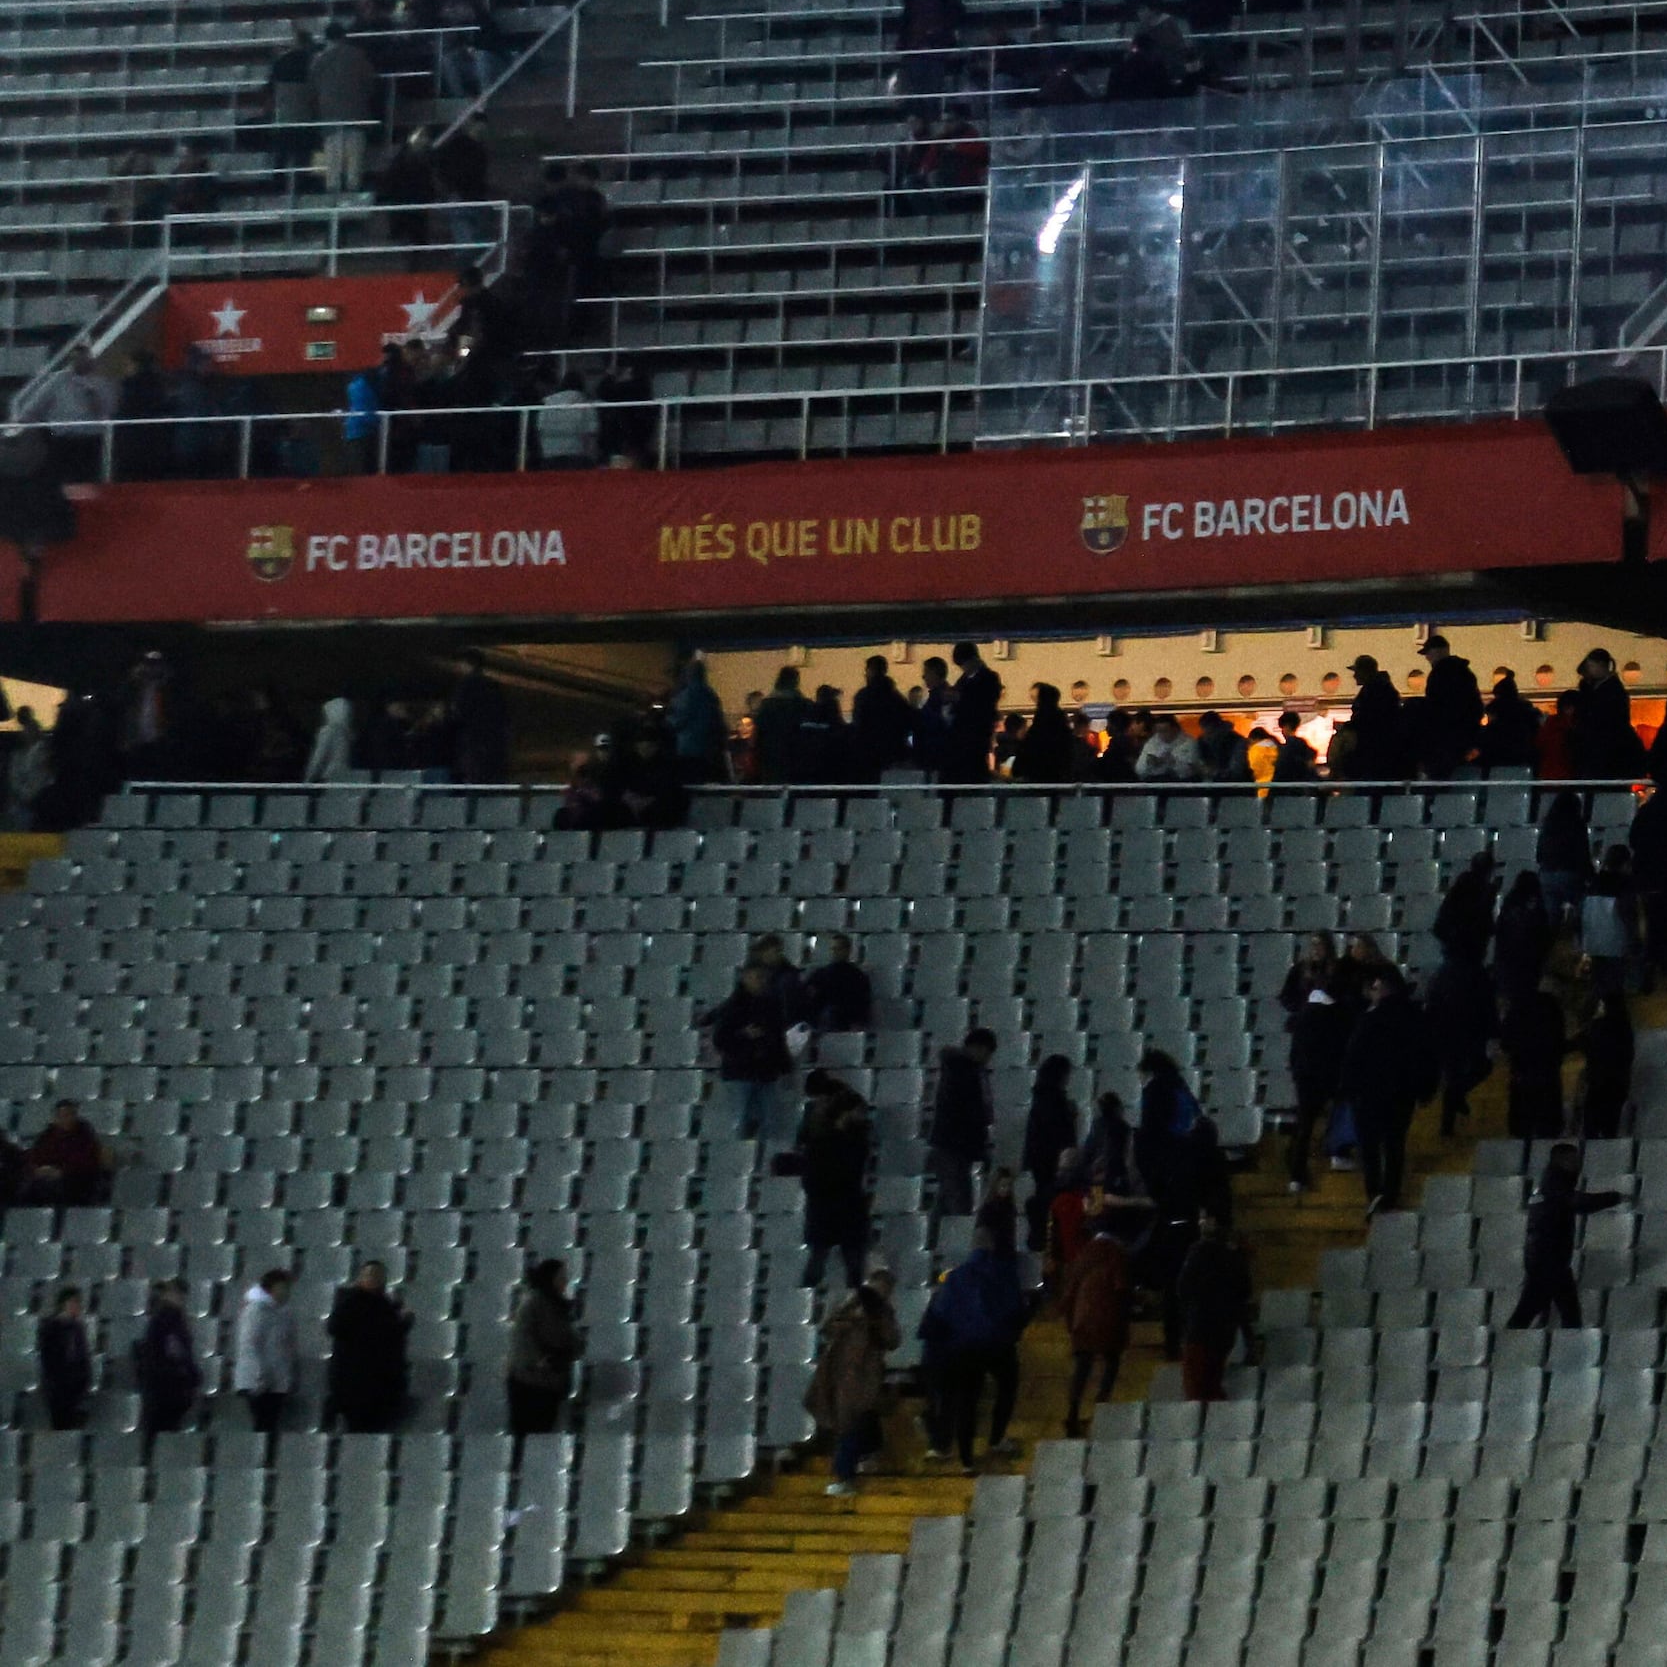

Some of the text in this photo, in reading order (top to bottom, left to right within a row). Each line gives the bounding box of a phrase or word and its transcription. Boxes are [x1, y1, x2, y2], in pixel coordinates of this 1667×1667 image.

[658, 514, 982, 565] MÉS QUE UN CLUB
[1141, 488, 1410, 541] FC BARCELONA
[306, 529, 566, 571] FC BARCELONA
